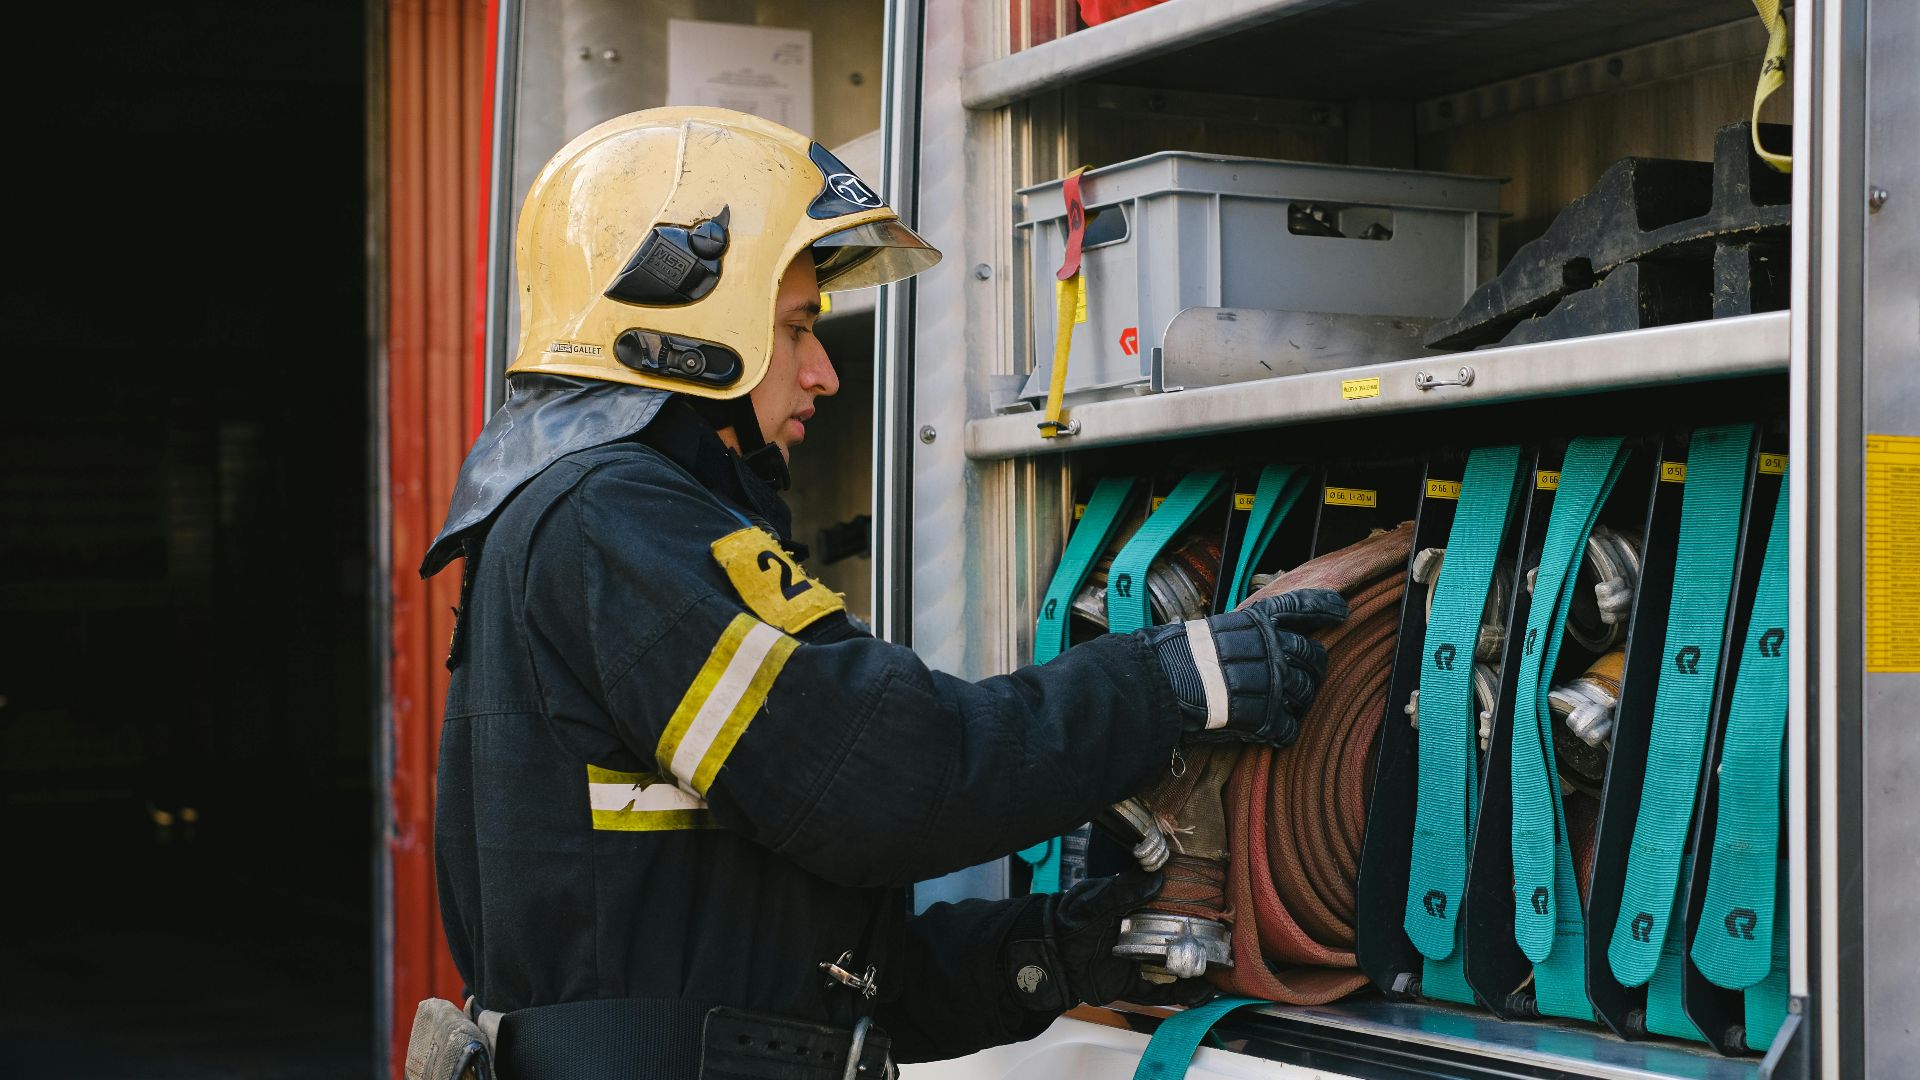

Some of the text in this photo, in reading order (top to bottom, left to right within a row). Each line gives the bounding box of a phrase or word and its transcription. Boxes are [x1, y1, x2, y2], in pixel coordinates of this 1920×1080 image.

[654, 247, 687, 272] MSA
[573, 345, 602, 355] GALLET
[757, 550, 813, 601] 2
